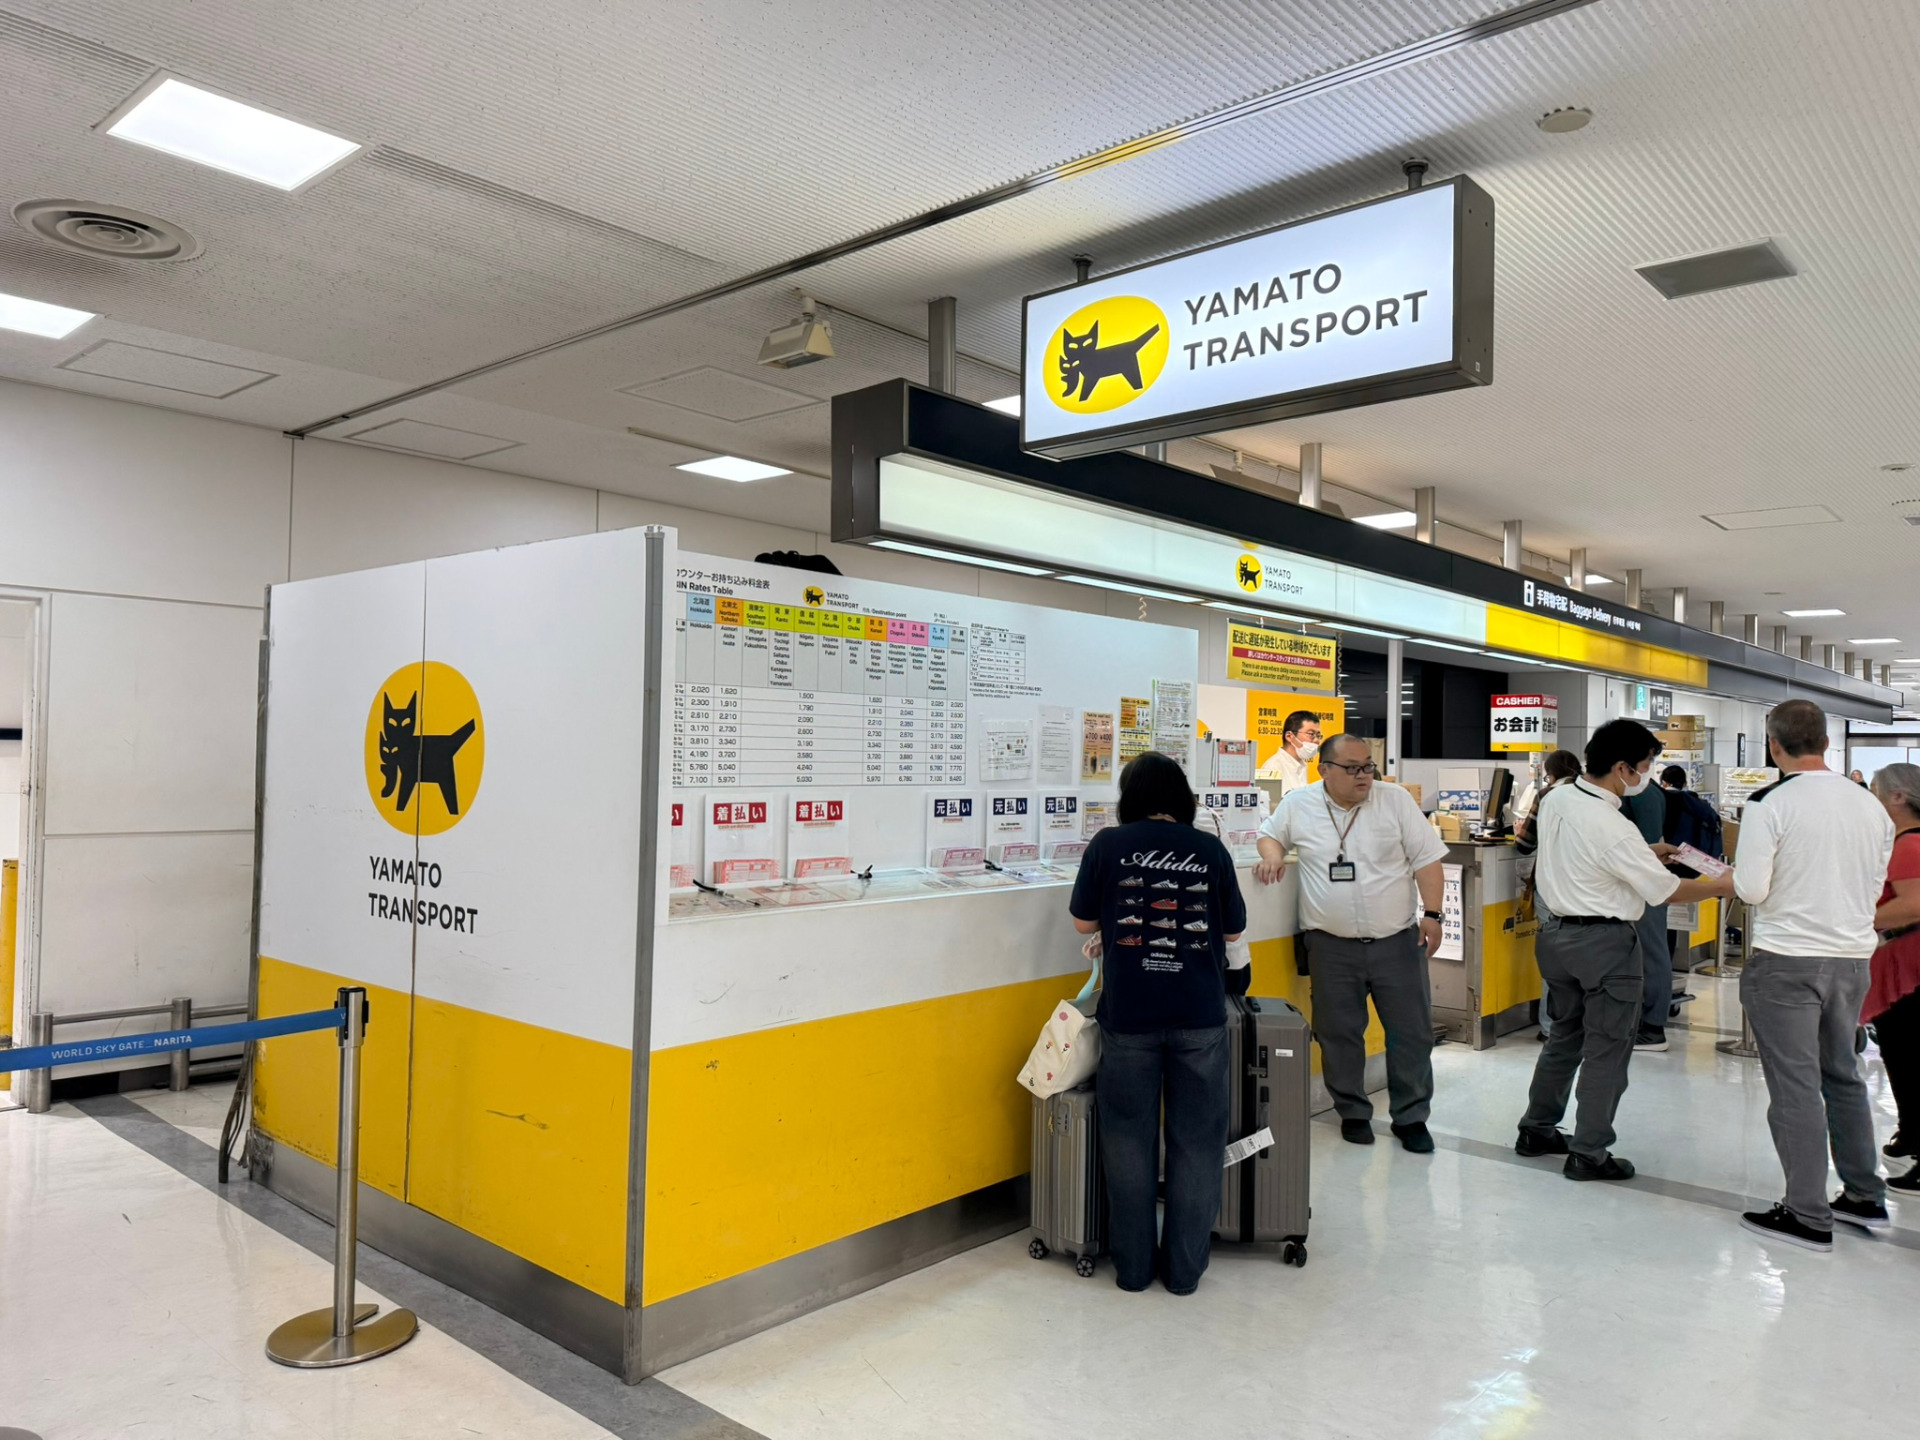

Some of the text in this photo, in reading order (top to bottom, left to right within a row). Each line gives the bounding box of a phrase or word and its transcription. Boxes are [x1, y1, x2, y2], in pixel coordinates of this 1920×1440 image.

[1184, 263, 1342, 326] YAMATO
[1183, 289, 1428, 371] TRANSPORT
[1264, 565, 1291, 580] YAMATO
[690, 582, 711, 593] Rates
[712, 586, 734, 596] Table
[1264, 579, 1303, 596] TRANSPORT
[692, 597, 710, 606] 北海道
[826, 592, 849, 600] YAMATO
[690, 606, 712, 614] Hokkaido
[721, 600, 738, 610] 北東北
[826, 600, 859, 610] TRANSPORT
[719, 610, 740, 618] Northern
[720, 616, 738, 624] Tohoku
[746, 612, 766, 620] Southern
[1569, 600, 1592, 620] Baggage
[1592, 607, 1612, 627] Delivery
[720, 700, 737, 708] 1,910
[1496, 697, 1540, 705] CASHIER
[1494, 716, 1539, 732] お会計
[689, 776, 708, 784] 7,100
[936, 800, 971, 815] 元払い
[994, 800, 1026, 814] 元払い
[1047, 799, 1075, 810] 元払い
[1206, 795, 1228, 806] 元払い
[1236, 795, 1257, 806] 元払い
[716, 806, 764, 821] 着払い
[798, 804, 840, 818] 着払い
[1120, 850, 1208, 873] Adidas
[370, 856, 442, 888] YAMATO
[368, 892, 478, 934] TRANSPORT
[51, 1046, 92, 1060] WORLD
[95, 1044, 116, 1054] SKY
